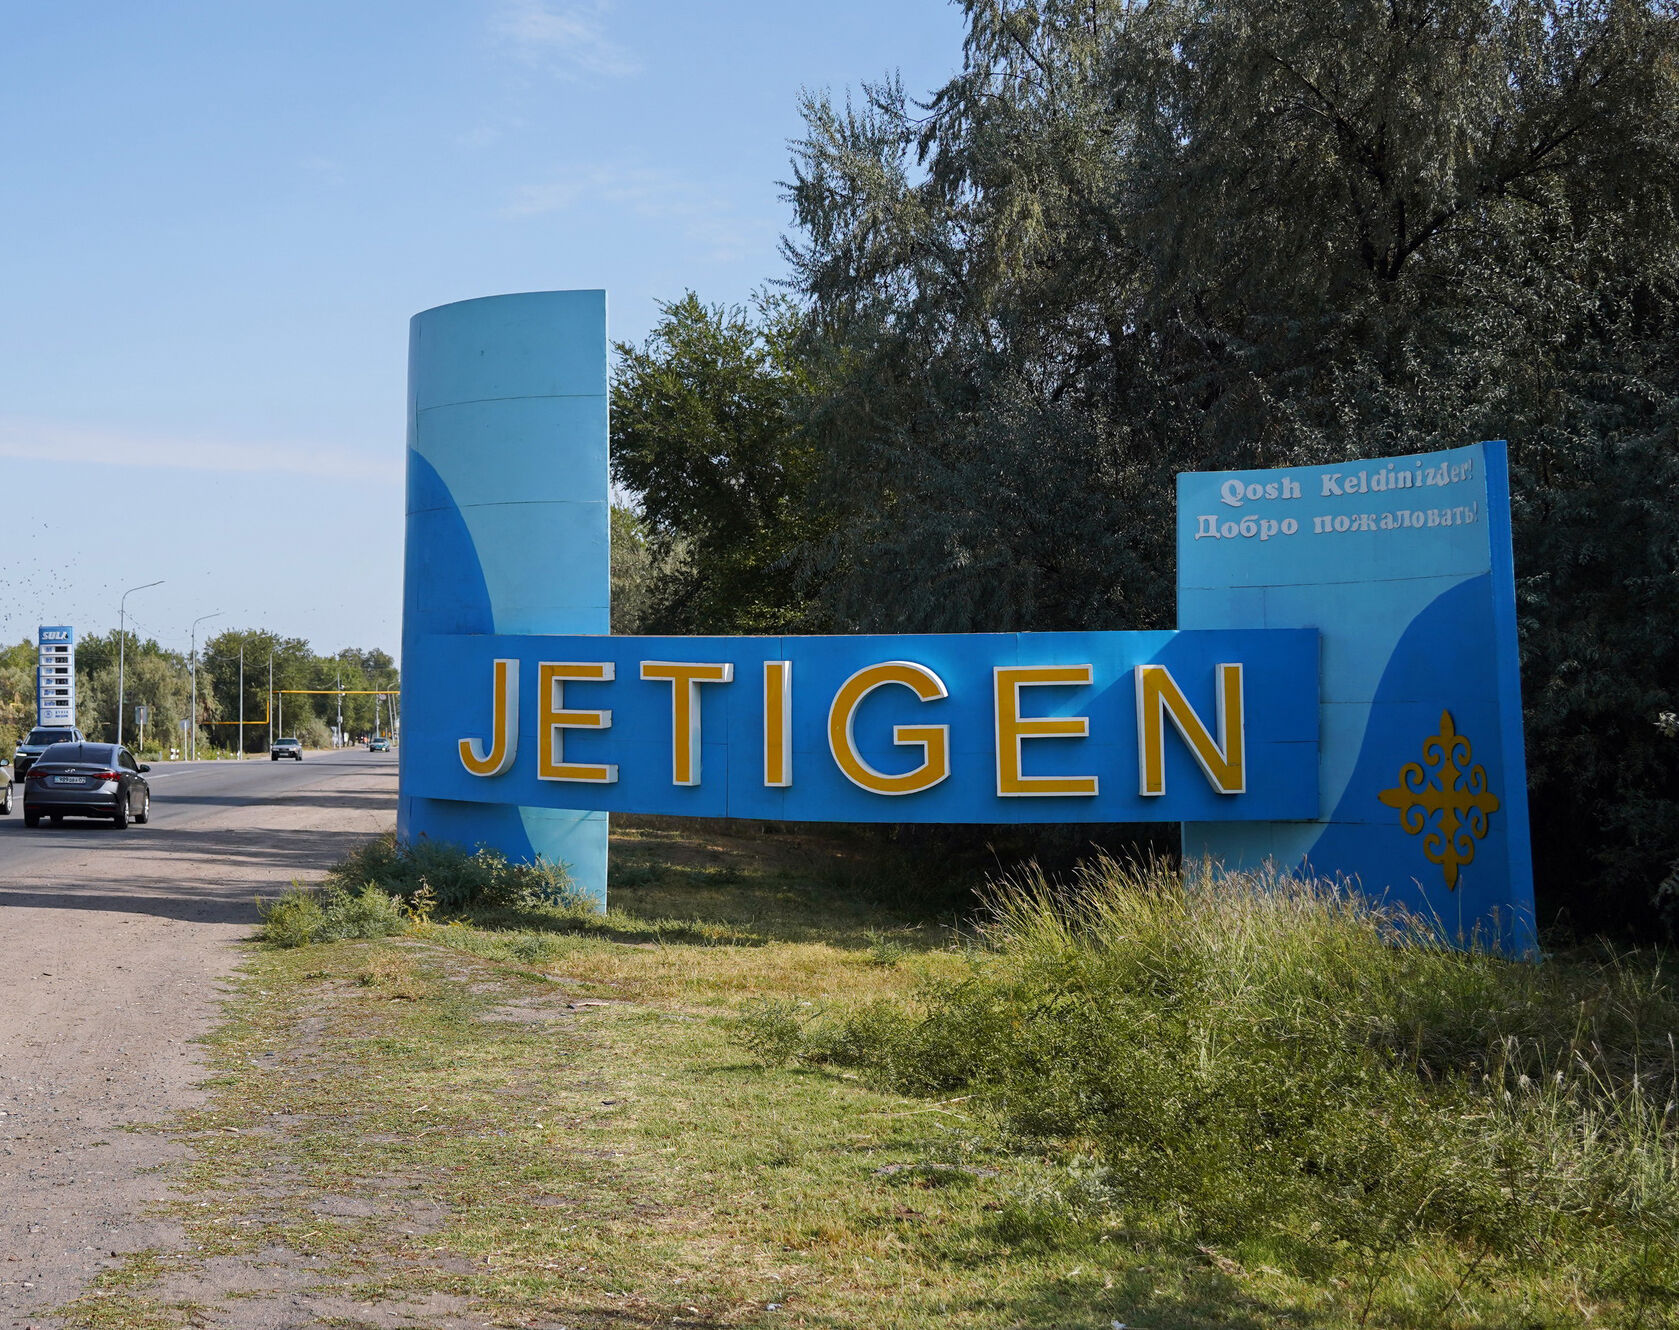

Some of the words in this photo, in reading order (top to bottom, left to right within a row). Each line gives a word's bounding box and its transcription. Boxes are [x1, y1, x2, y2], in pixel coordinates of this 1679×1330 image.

[1220, 477, 1302, 507] Qosh
[1320, 457, 1474, 497] Keldinizder!
[1194, 514, 1299, 541] Добро
[1313, 501, 1479, 534] пожаловать!
[458, 658, 1246, 797] JETIGEN
